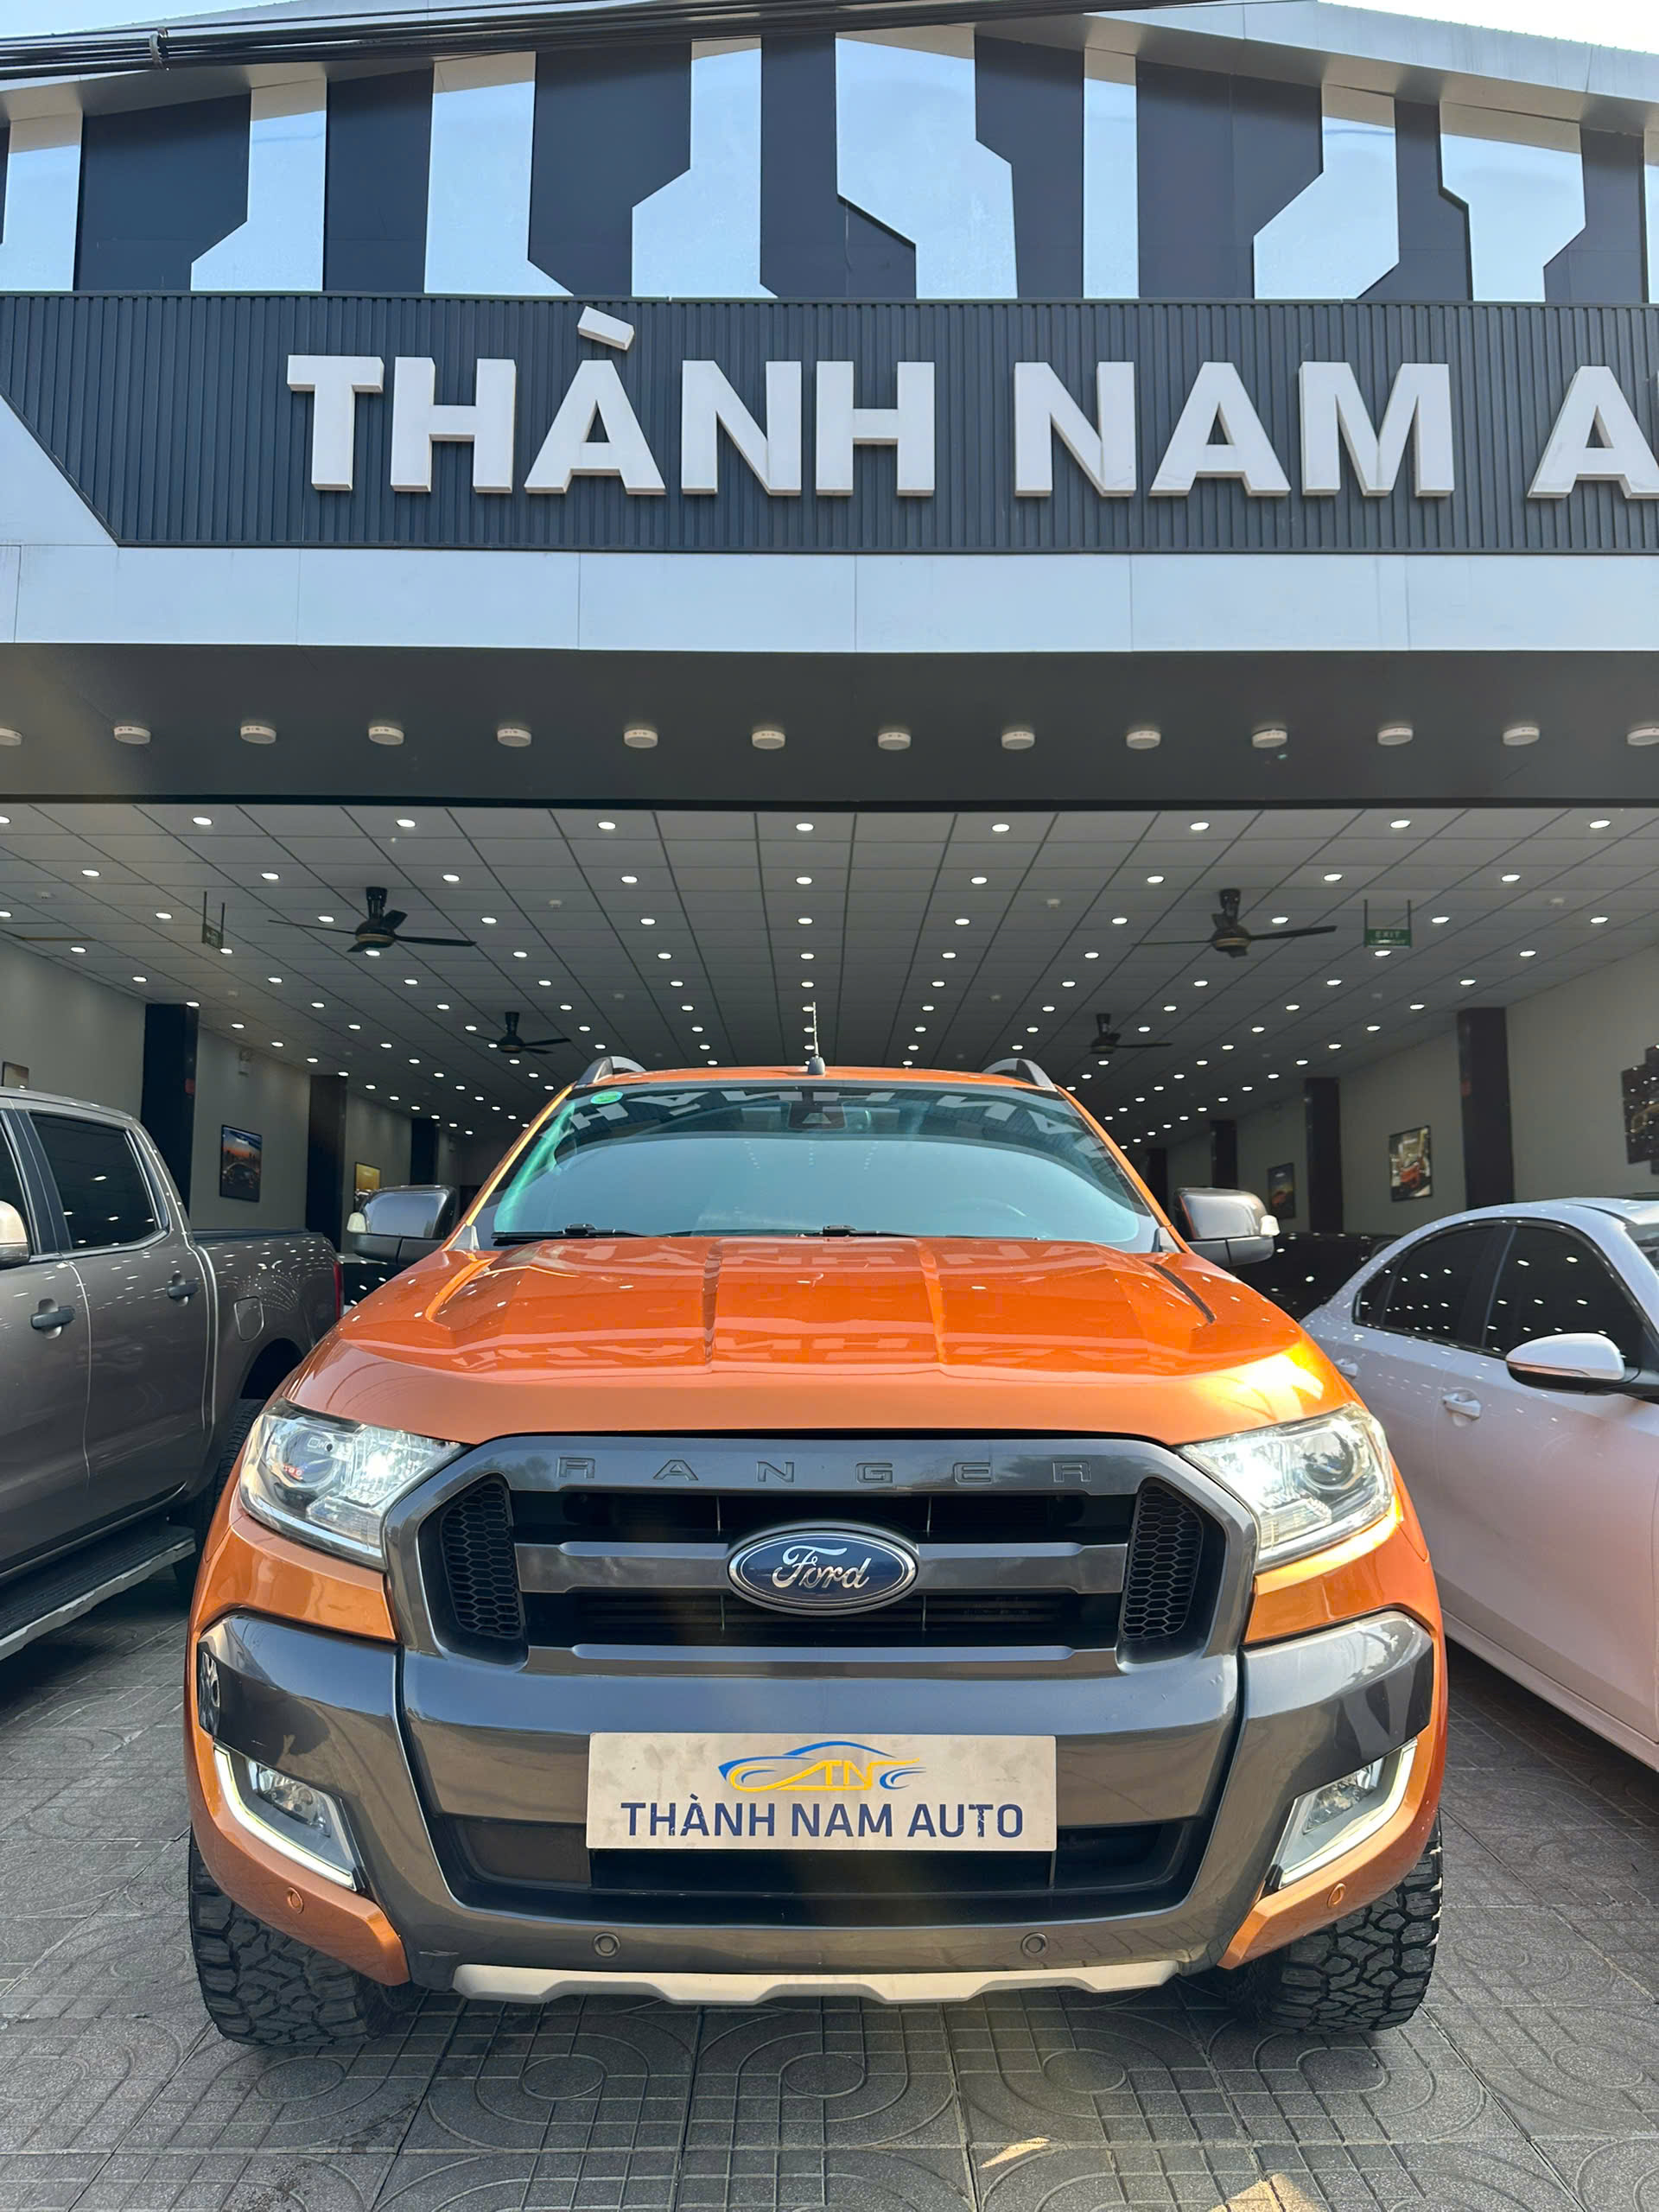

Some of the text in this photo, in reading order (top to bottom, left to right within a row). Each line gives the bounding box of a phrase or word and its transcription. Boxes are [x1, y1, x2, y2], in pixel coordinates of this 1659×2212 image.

[287, 306, 1659, 499] THÀNH NAM A
[558, 1457, 1092, 1484] RANGER
[772, 1545, 872, 1588] Ford
[620, 1793, 1024, 1839] THÀNH NAM AUTO
